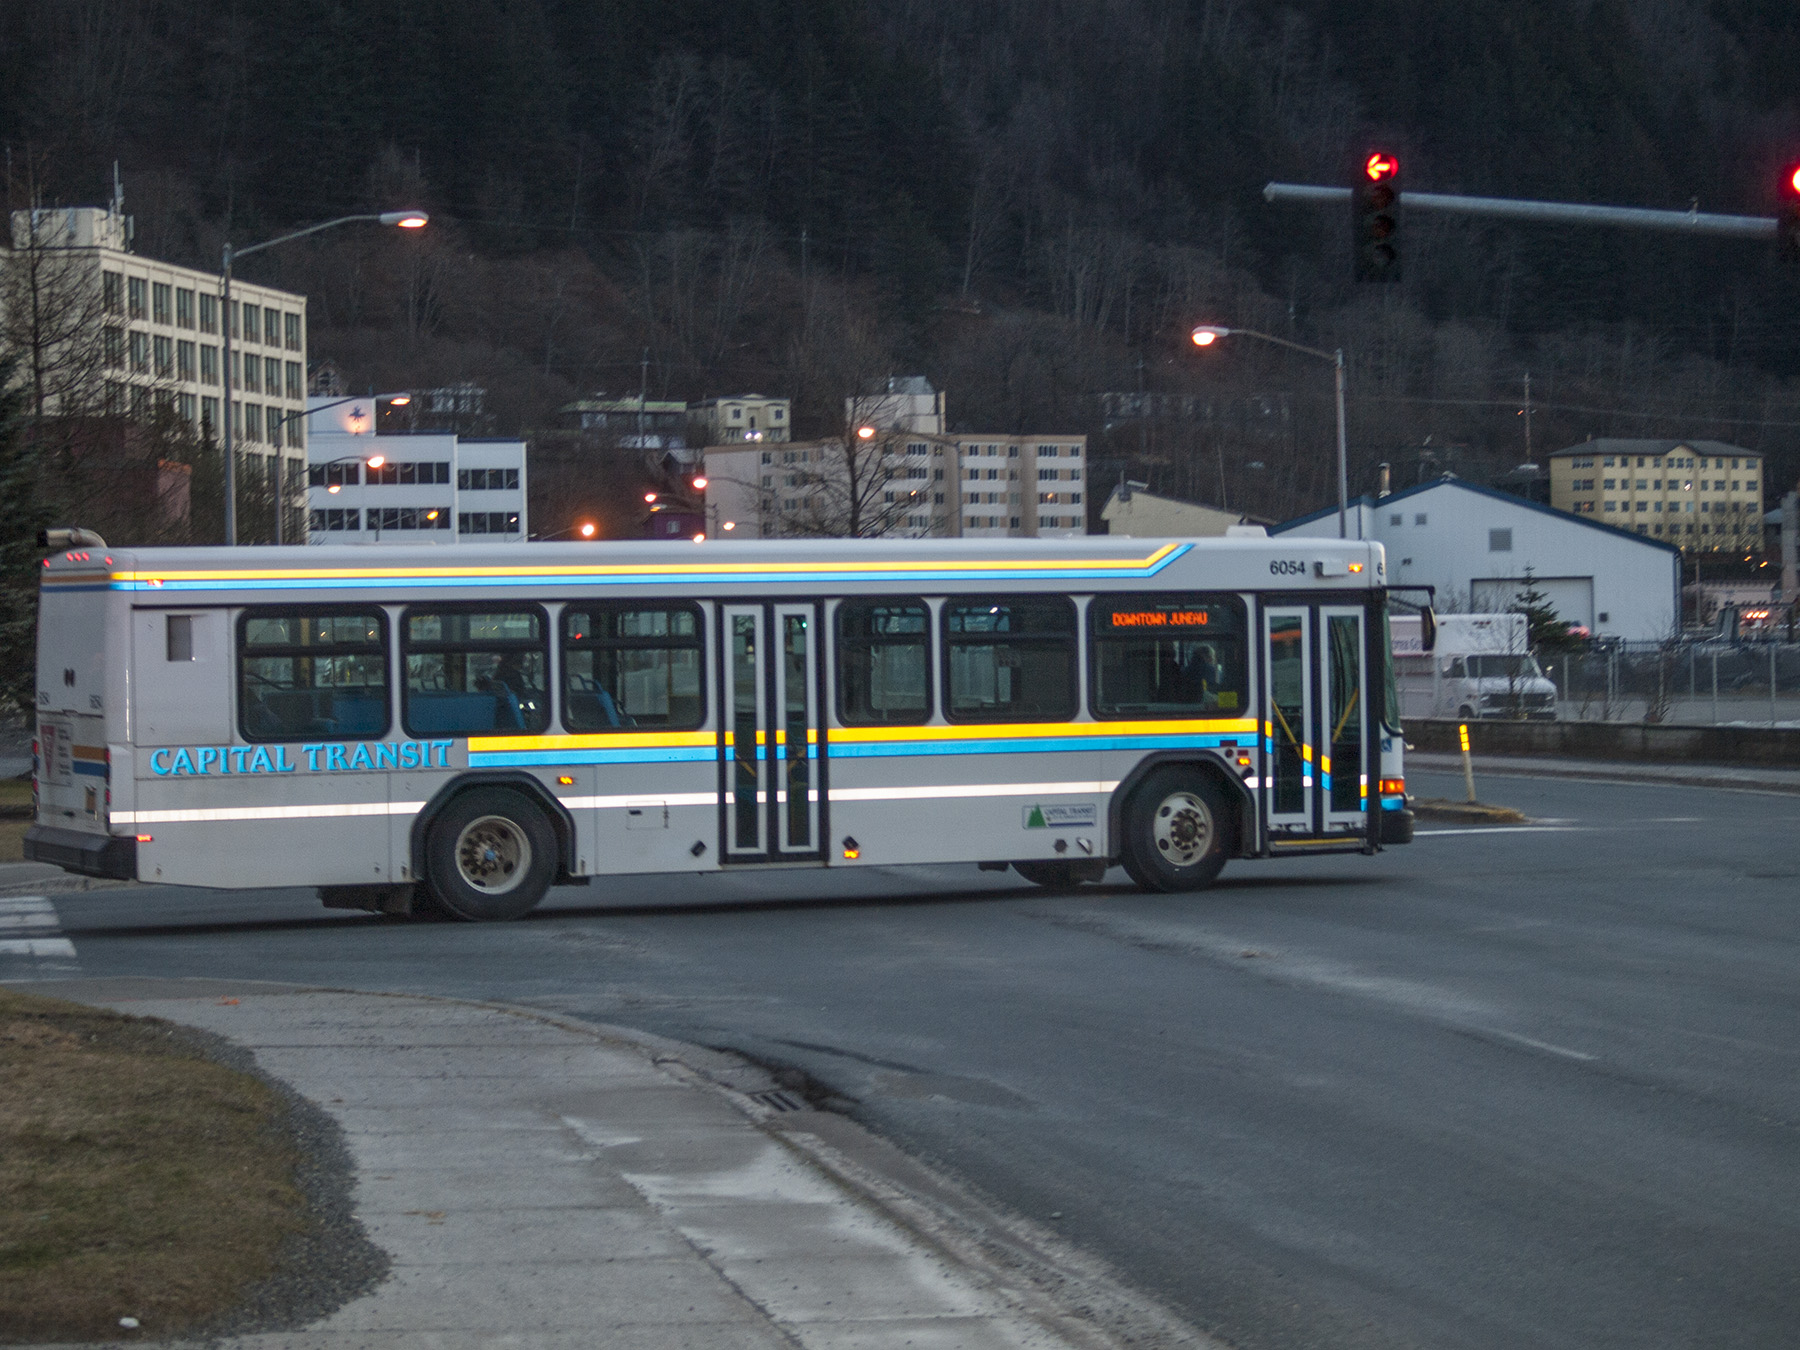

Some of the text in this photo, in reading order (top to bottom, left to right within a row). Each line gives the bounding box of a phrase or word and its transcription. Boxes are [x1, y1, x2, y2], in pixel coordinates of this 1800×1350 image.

[1269, 560, 1306, 575] 6054
[1112, 611, 1208, 627] DOWNTOWN JUNEAU
[150, 739, 454, 776] CAPITAL TRANSIT
